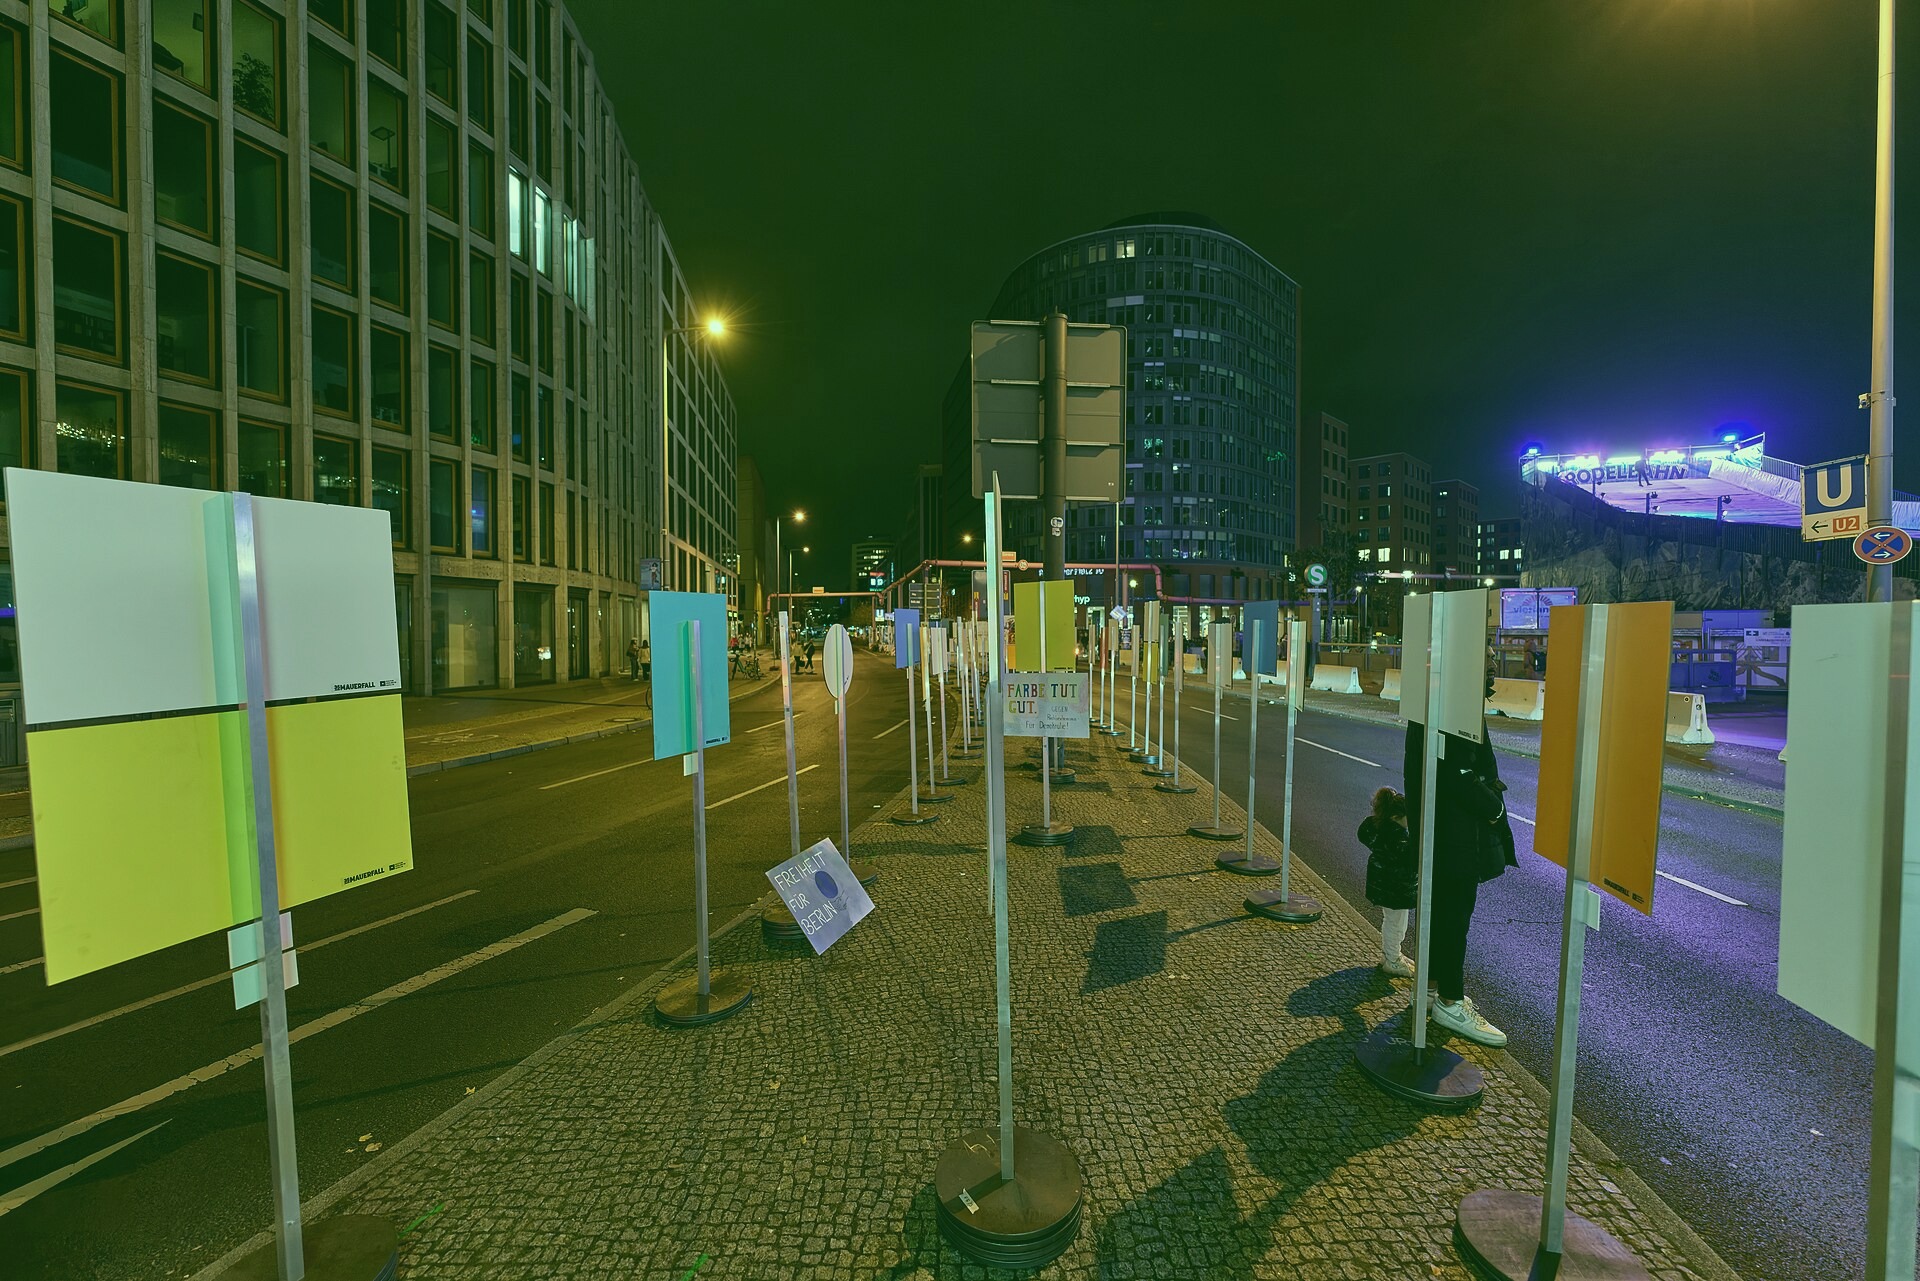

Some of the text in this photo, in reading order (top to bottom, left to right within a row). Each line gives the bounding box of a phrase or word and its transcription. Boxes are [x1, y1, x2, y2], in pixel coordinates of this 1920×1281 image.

[1817, 464, 1852, 507] U
[1836, 518, 1857, 531] U2
[1311, 566, 1324, 585] S
[1074, 595, 1090, 604] hyp
[340, 682, 376, 691] MAUERFALL
[1007, 683, 1078, 698] FARBE TUT
[1008, 700, 1037, 714] GUT.
[349, 867, 386, 882] MAUERFALL
[774, 851, 826, 891] FREIHEIT
[788, 893, 811, 913] FÜR
[801, 901, 838, 935] BERLIN
